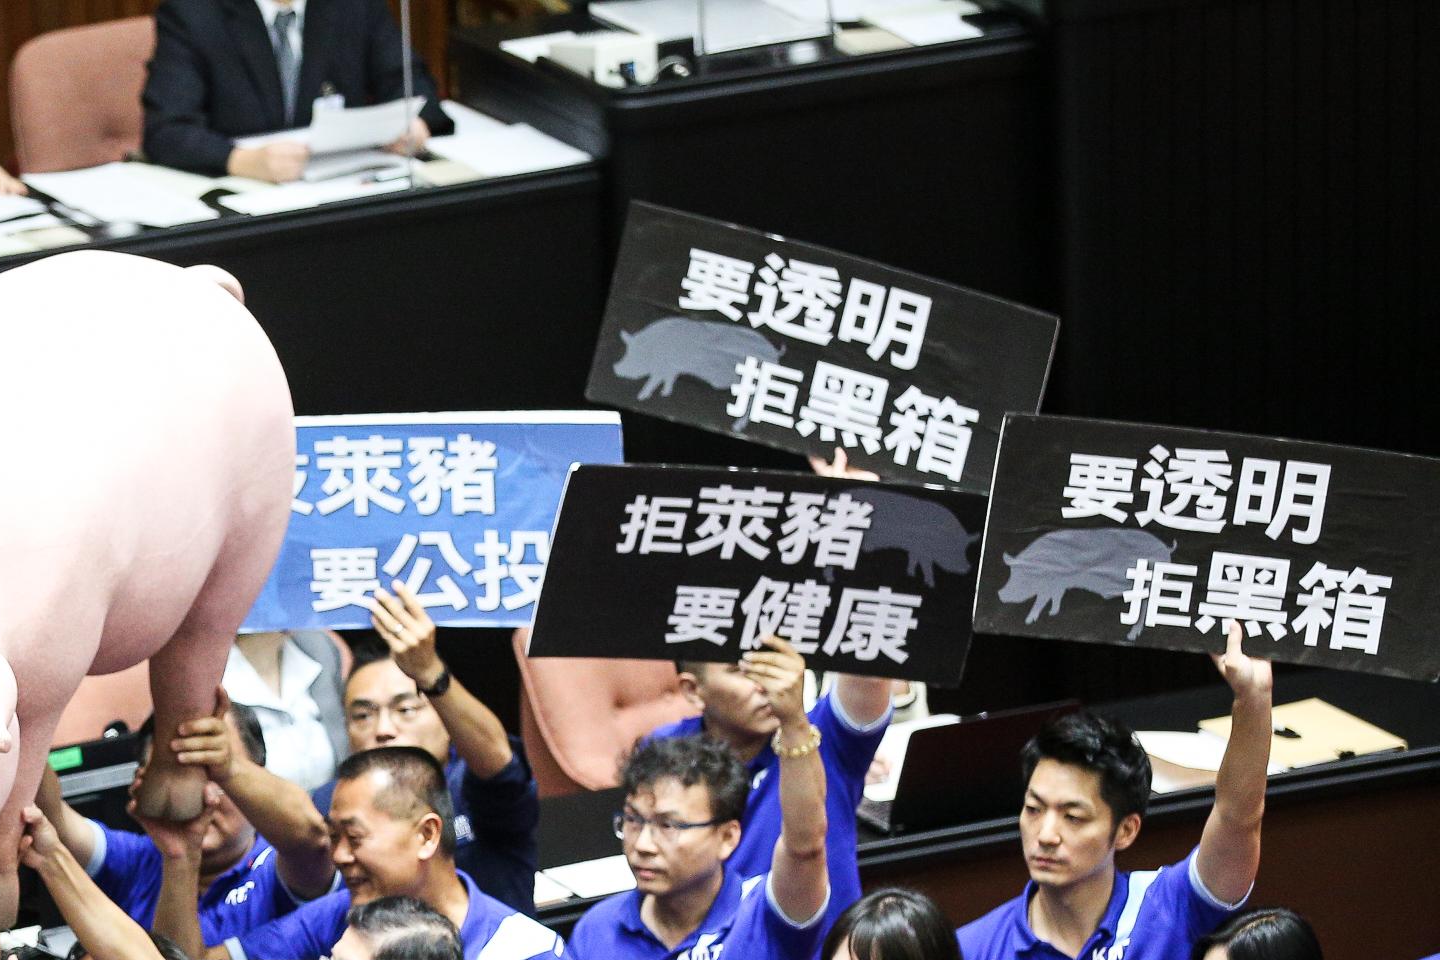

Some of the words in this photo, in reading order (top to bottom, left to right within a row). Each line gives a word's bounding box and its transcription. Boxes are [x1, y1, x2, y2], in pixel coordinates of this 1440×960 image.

[678, 247, 933, 371] 要透明
[726, 355, 980, 483] 拒黑箱
[291, 433, 499, 517] 萊豬
[1061, 444, 1332, 545] 要透明
[309, 529, 550, 612] 要公投
[615, 484, 874, 571] 拒萊豬
[664, 575, 922, 665] 要健康
[1120, 551, 1393, 656] 拒黑箱
